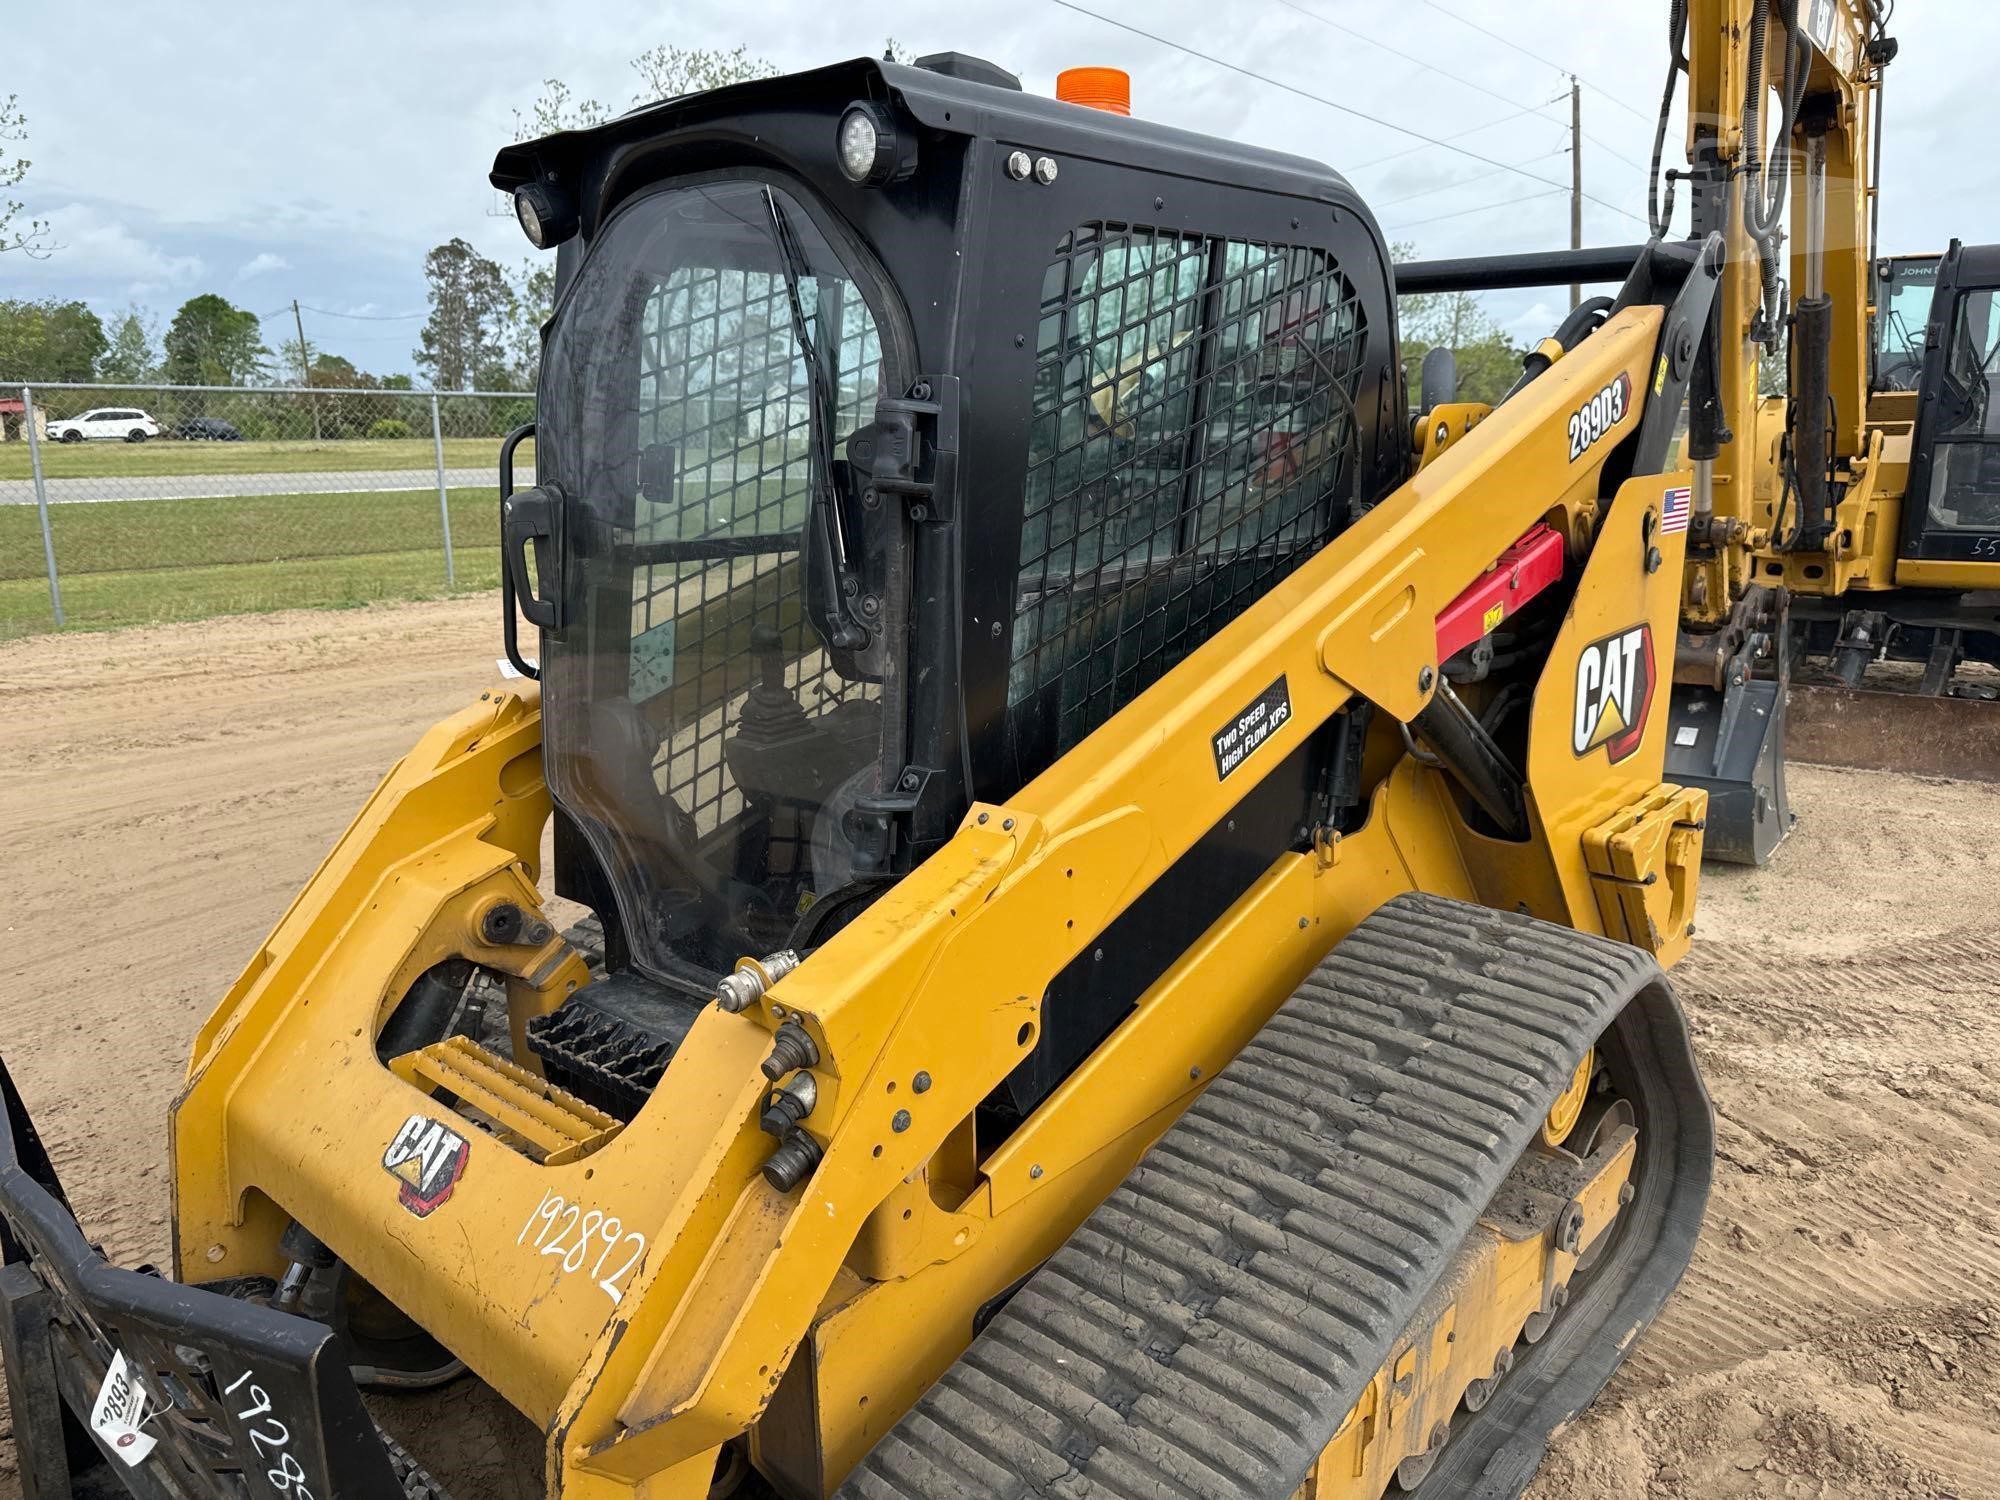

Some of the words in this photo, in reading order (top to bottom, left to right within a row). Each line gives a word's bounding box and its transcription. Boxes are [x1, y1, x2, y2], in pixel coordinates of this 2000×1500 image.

[1900, 267, 1932, 276] JOHN
[1568, 378, 1623, 462] 289D3
[1269, 701, 1288, 731] XPS
[1575, 628, 1643, 752] CAT
[384, 1114, 464, 1193] CAT
[516, 1186, 646, 1306] 192892
